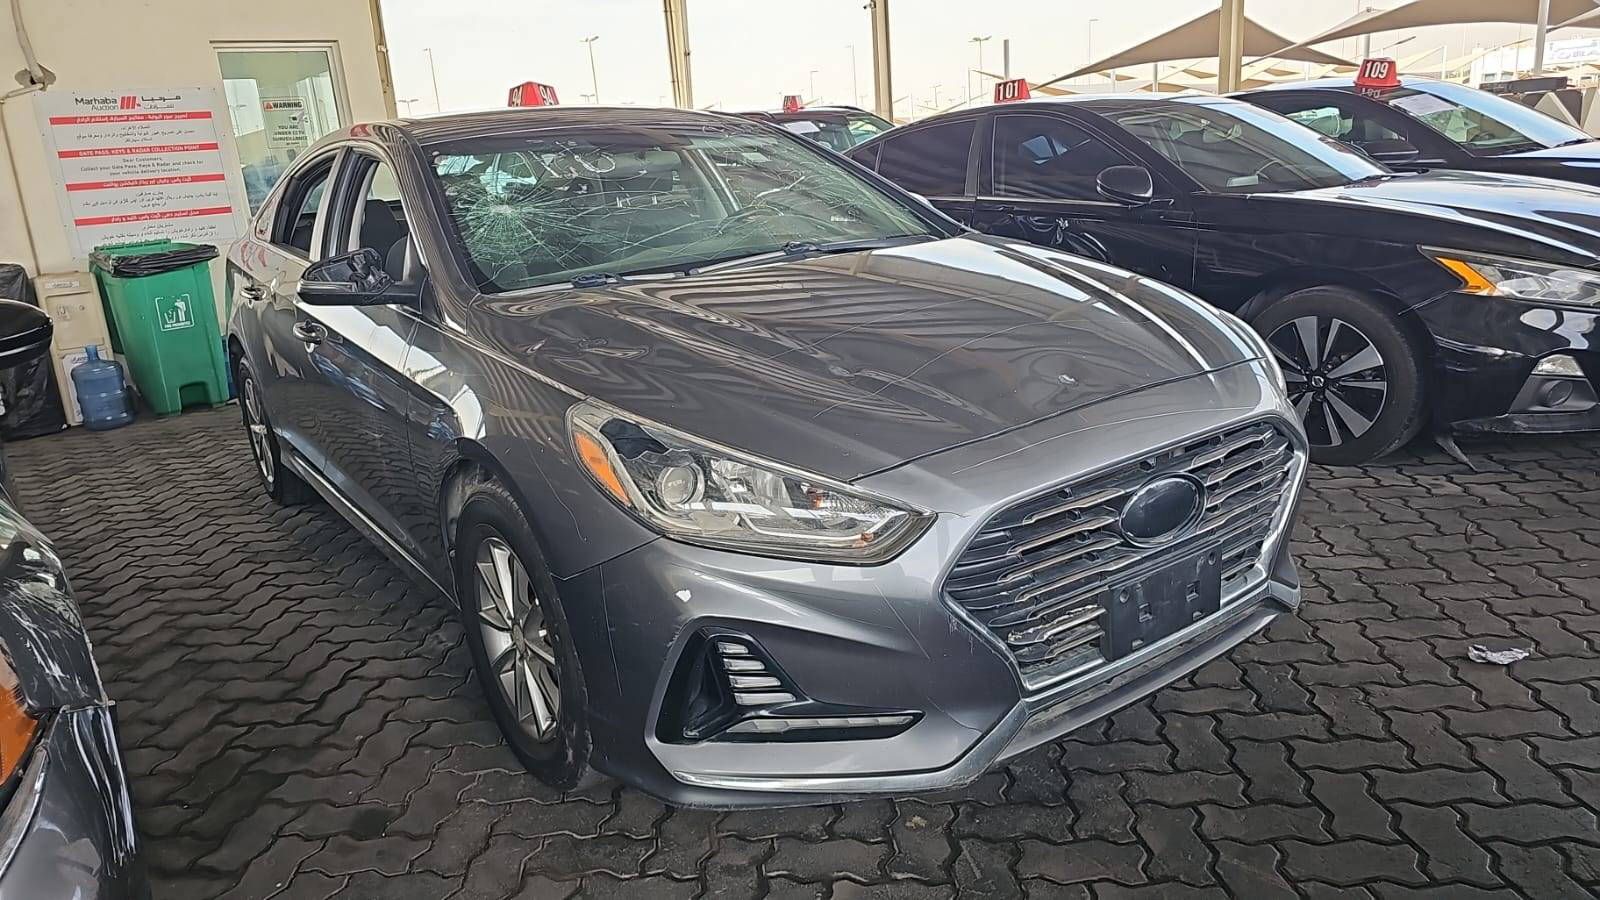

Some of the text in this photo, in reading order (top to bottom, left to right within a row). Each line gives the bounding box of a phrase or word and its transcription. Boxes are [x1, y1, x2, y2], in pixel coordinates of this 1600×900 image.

[1364, 61, 1389, 78] 109
[540, 86, 554, 106] 94
[999, 80, 1018, 100] 101
[75, 97, 117, 105] Marhaba
